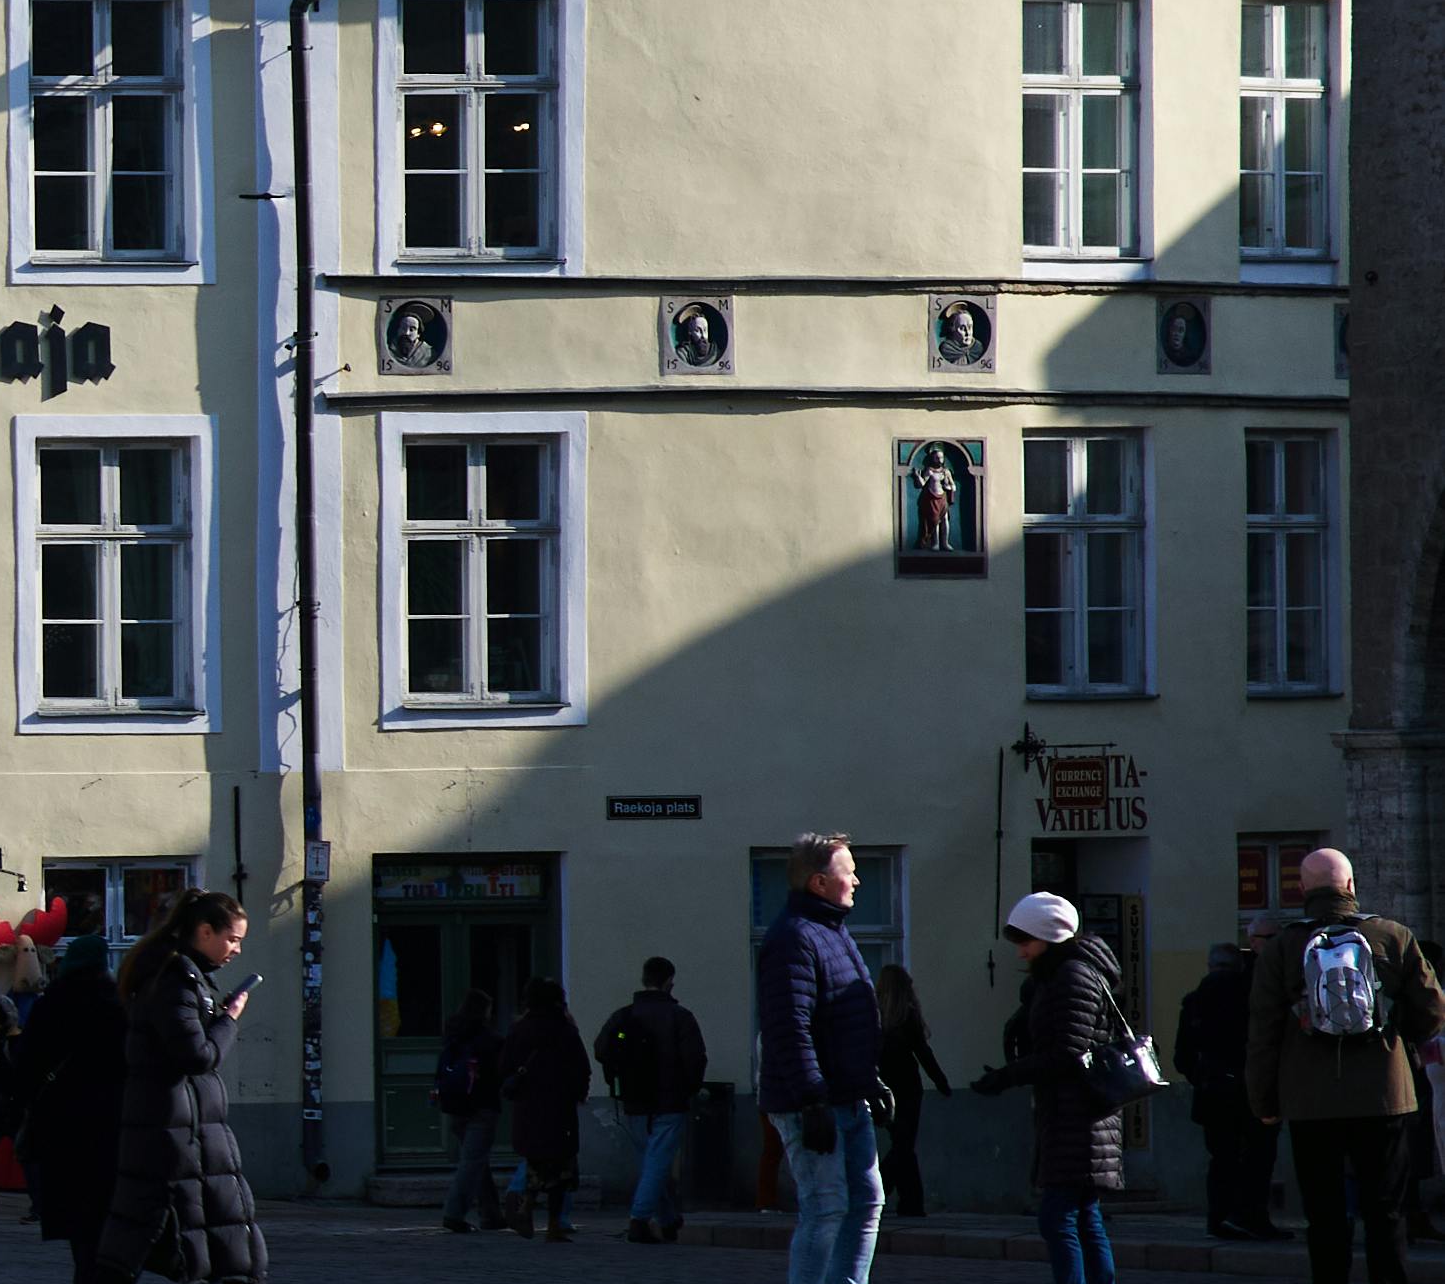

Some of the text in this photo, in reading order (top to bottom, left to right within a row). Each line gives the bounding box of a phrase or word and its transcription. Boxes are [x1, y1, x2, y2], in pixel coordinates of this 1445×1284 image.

[1035, 755, 1148, 788] VTA-
[1054, 769, 1103, 782] CURRENCY
[1055, 785, 1103, 798] EXCHANGE
[614, 801, 695, 816] Raekoja plats
[1034, 797, 1148, 831] VAHETUS
